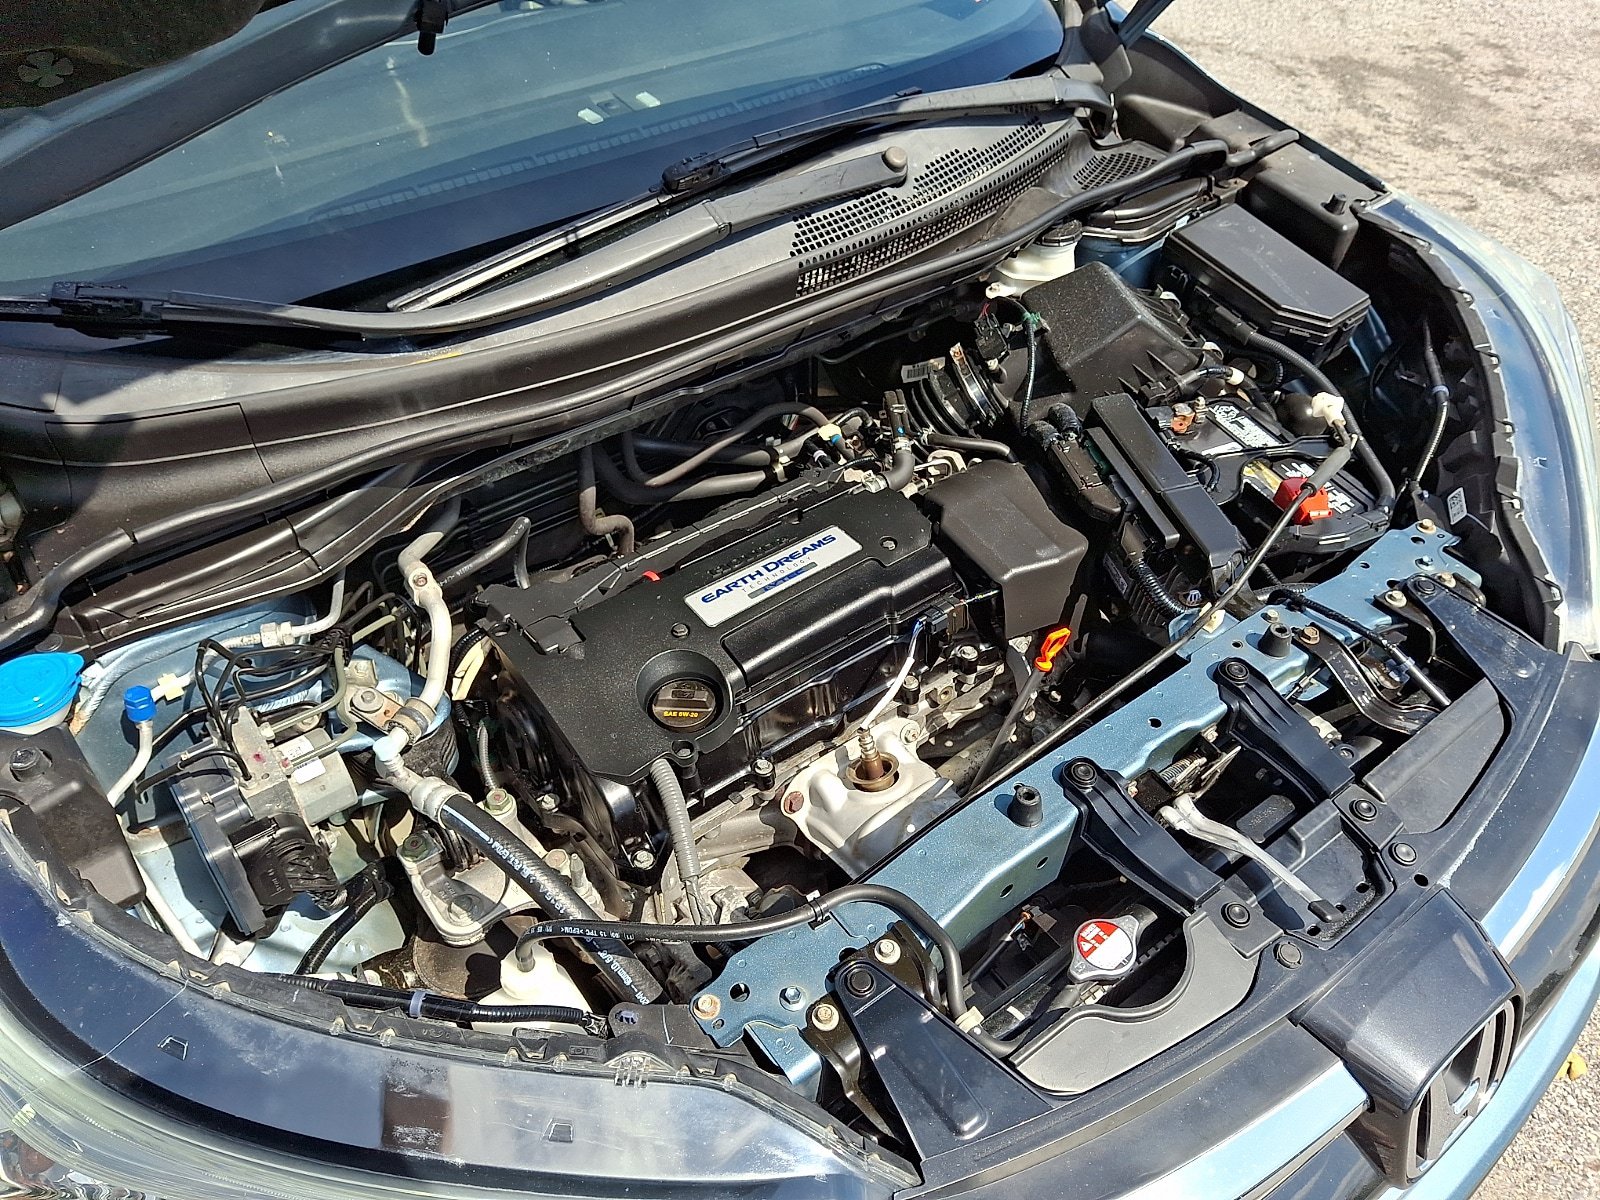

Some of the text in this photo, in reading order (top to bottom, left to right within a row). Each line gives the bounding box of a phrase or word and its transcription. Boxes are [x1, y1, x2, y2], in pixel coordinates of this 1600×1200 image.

[701, 570, 762, 603] EARTH
[762, 535, 836, 573] DREAMS
[742, 556, 811, 593] TECHNOLOGY
